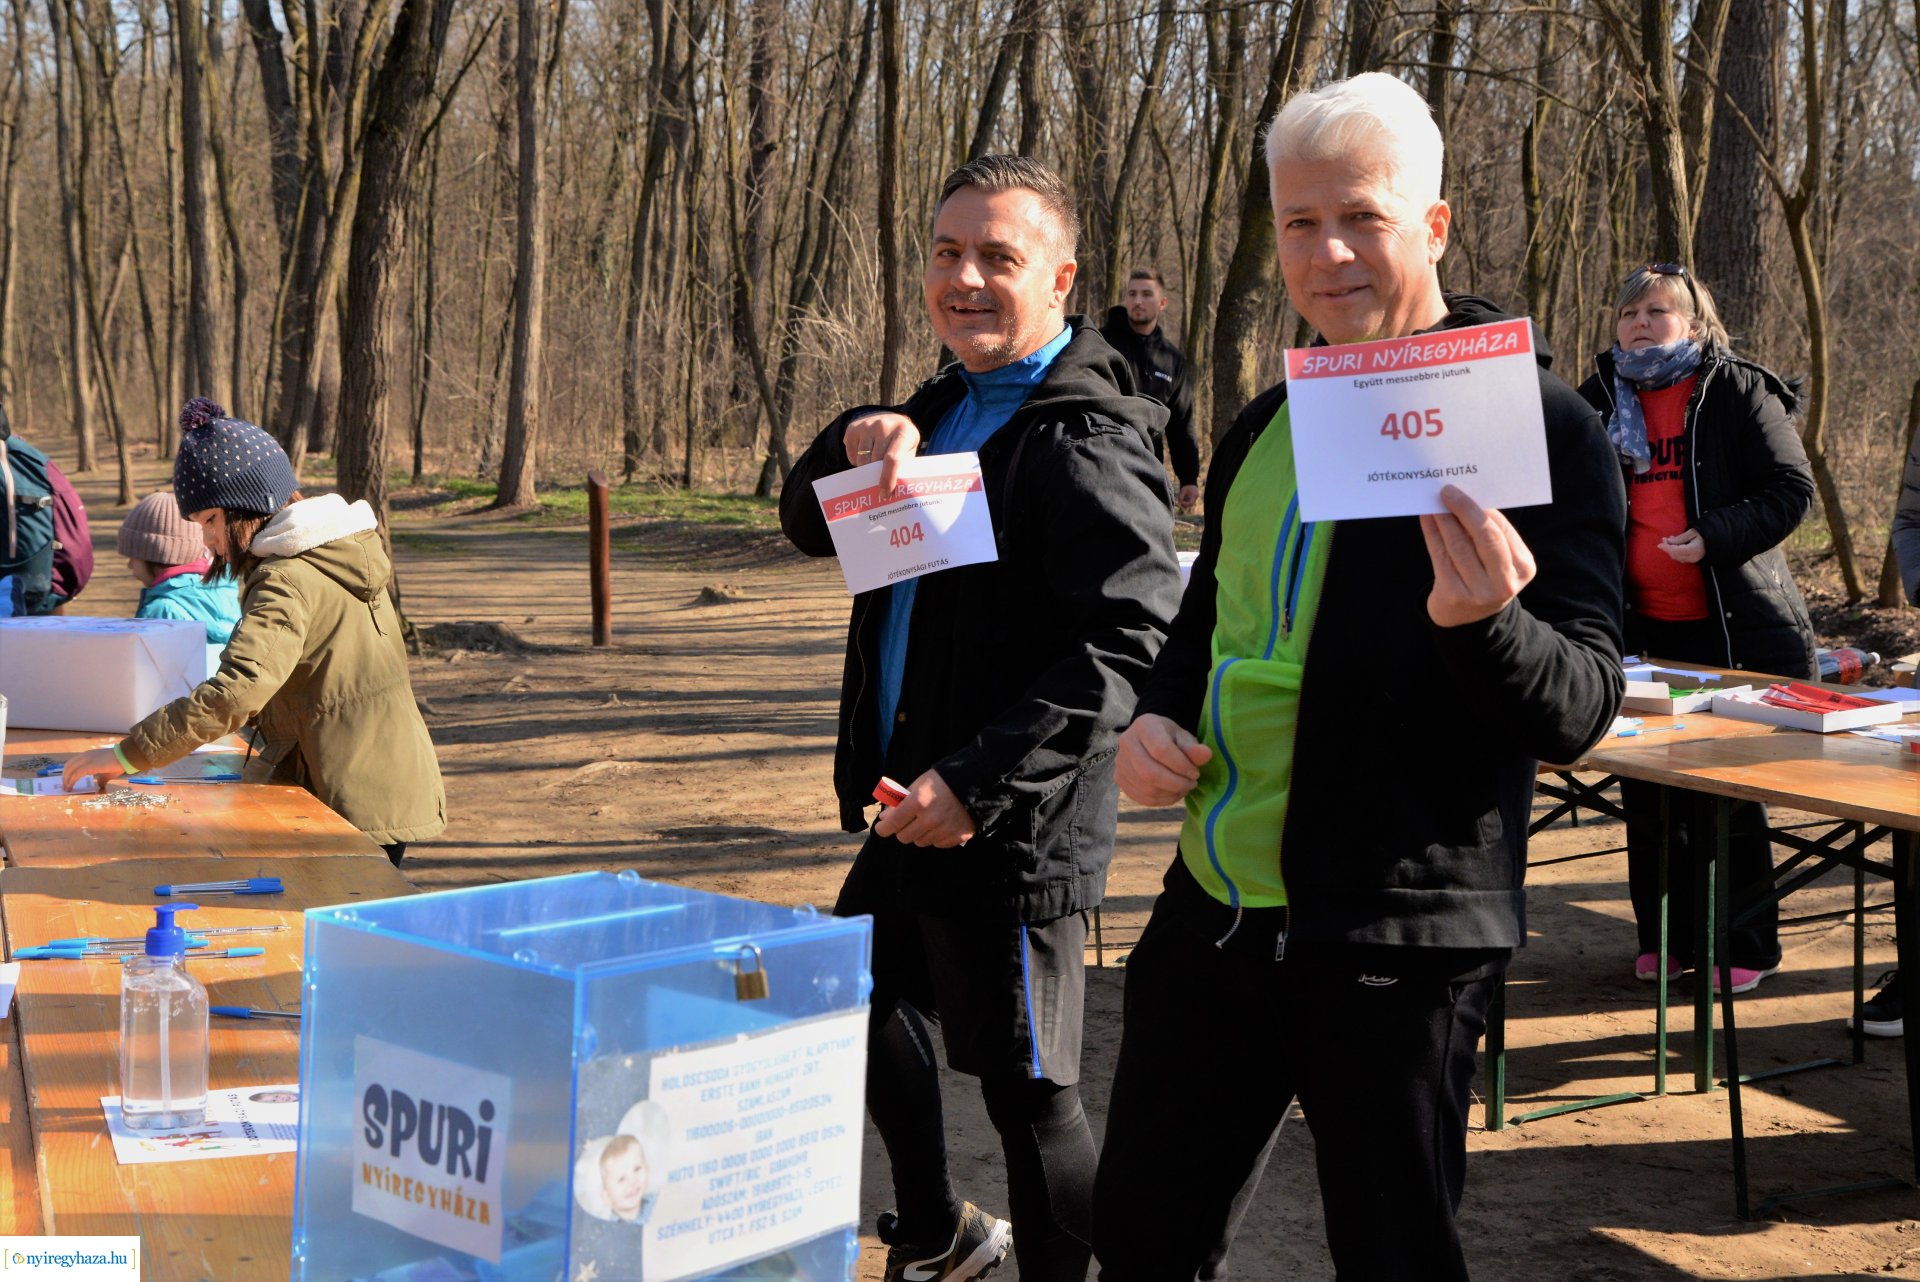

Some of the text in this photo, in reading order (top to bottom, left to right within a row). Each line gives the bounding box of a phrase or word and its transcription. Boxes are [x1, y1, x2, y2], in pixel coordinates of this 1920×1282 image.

[1302, 331, 1518, 374] SPURI NYÍREGYHÁZA
[1353, 366, 1471, 389] Együtt messzebbre jutunk
[1380, 408, 1444, 441] 405
[1648, 436, 1686, 466] PUR
[1366, 464, 1478, 483] JÓTÉKONYSÁGI FUTÁS
[834, 494, 872, 516] SPURI
[868, 511, 887, 522] Együtt
[888, 502, 919, 518] messzebbre
[889, 522, 925, 549] 404
[887, 558, 950, 581] JÓTÉKONYSÁGI FUTÁS
[701, 1084, 734, 1102] ERSTE
[668, 1166, 695, 1184] HU70
[362, 1162, 490, 1225] NYÍREGYHÁZA
[708, 1227, 735, 1244] UTCA
